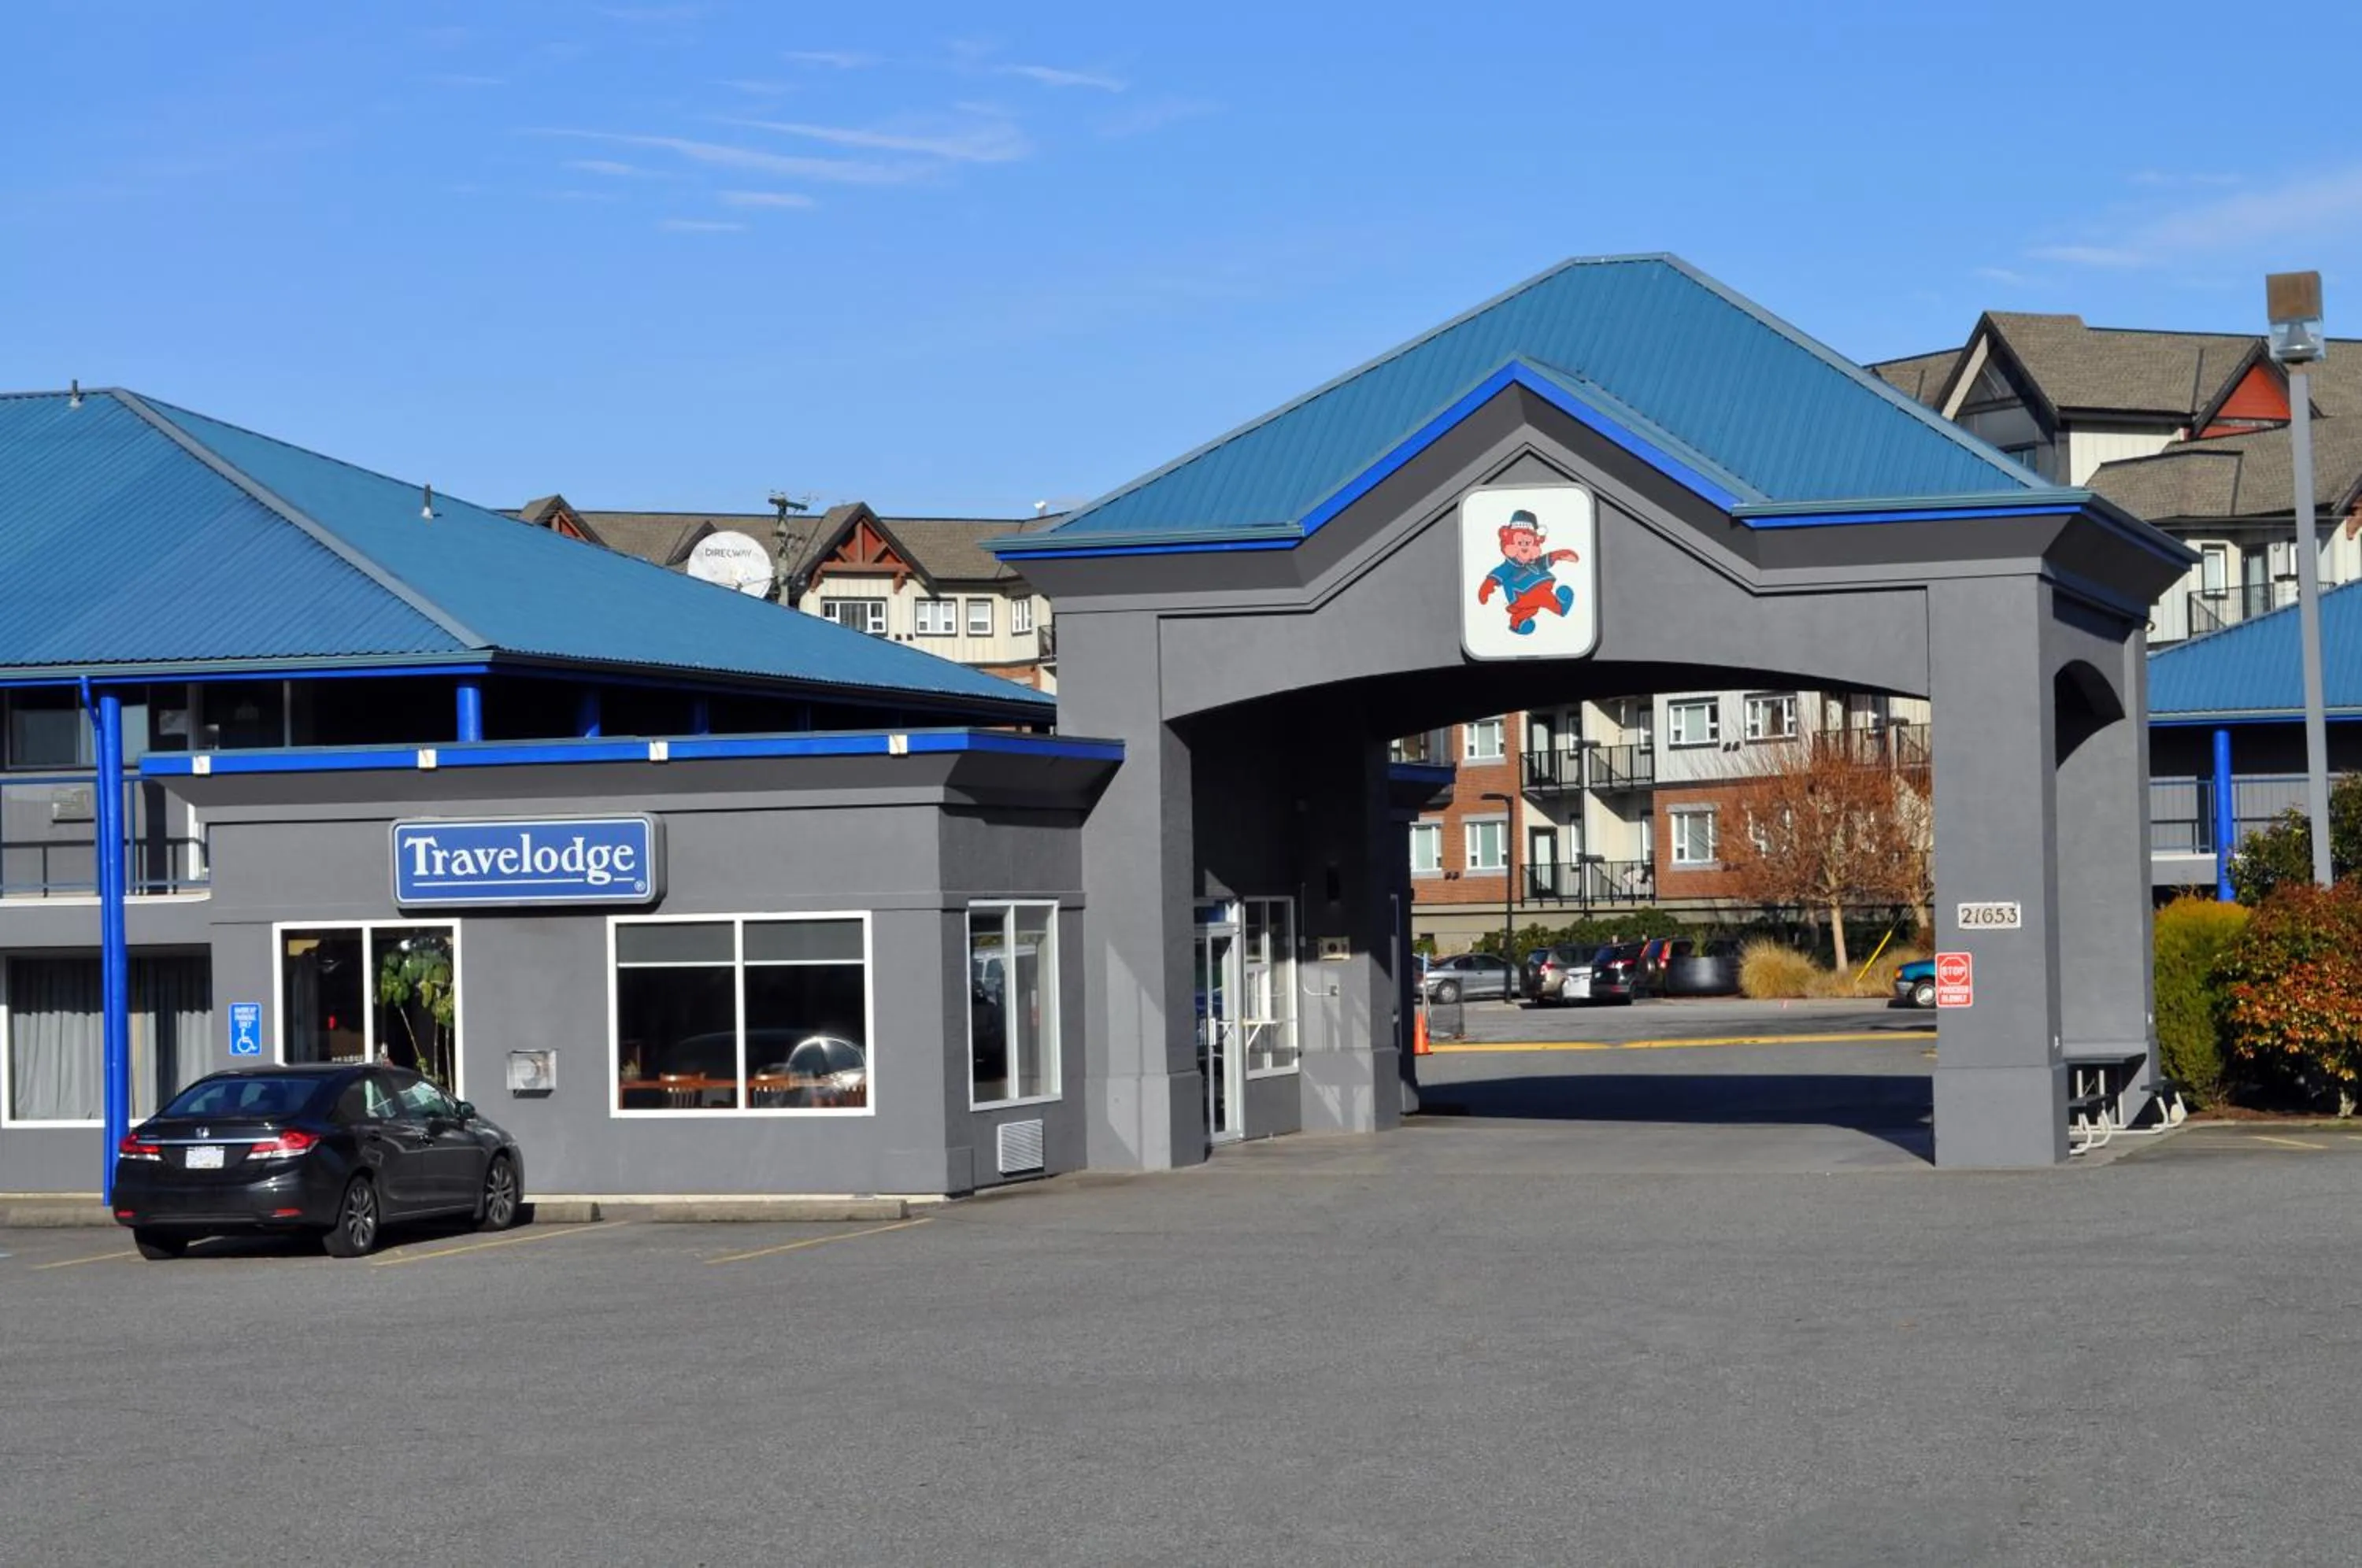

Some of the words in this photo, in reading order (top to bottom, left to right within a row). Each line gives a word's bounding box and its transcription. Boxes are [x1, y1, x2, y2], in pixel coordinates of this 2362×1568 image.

[705, 547, 752, 558] DIRECWAY
[404, 833, 635, 885] Travelodge
[1961, 908, 2018, 924] 21653
[1941, 965, 1966, 977] STOP
